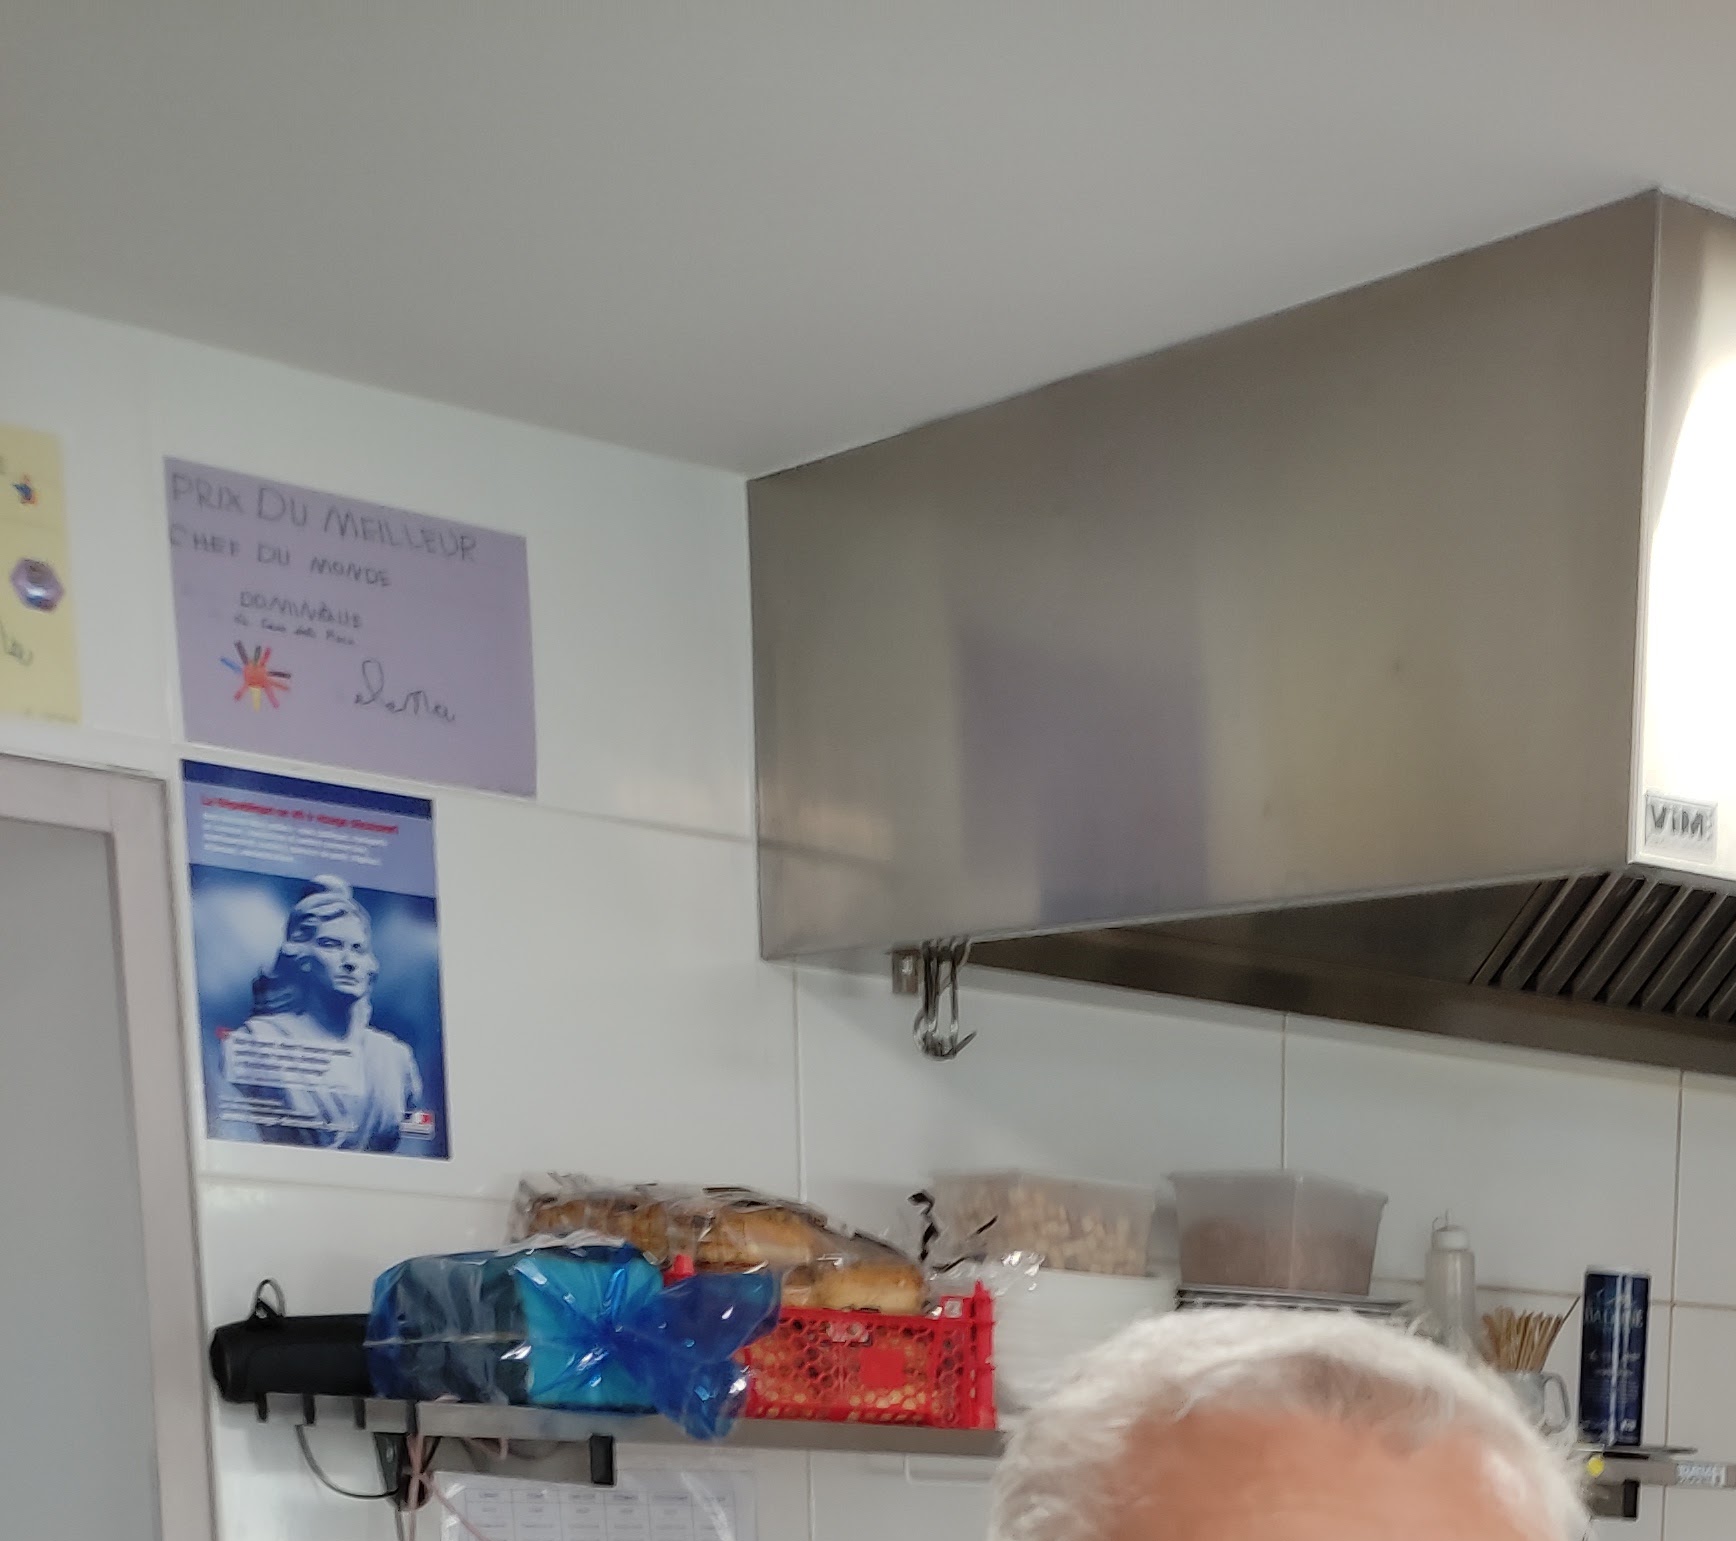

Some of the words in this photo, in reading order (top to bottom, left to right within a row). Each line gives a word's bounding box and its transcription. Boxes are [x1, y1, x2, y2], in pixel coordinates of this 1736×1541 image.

[170, 472, 244, 516] PRIX
[256, 487, 308, 528] DU
[323, 503, 478, 562] MEILLEUR
[257, 543, 291, 567] DU
[309, 555, 392, 588] MONDE
